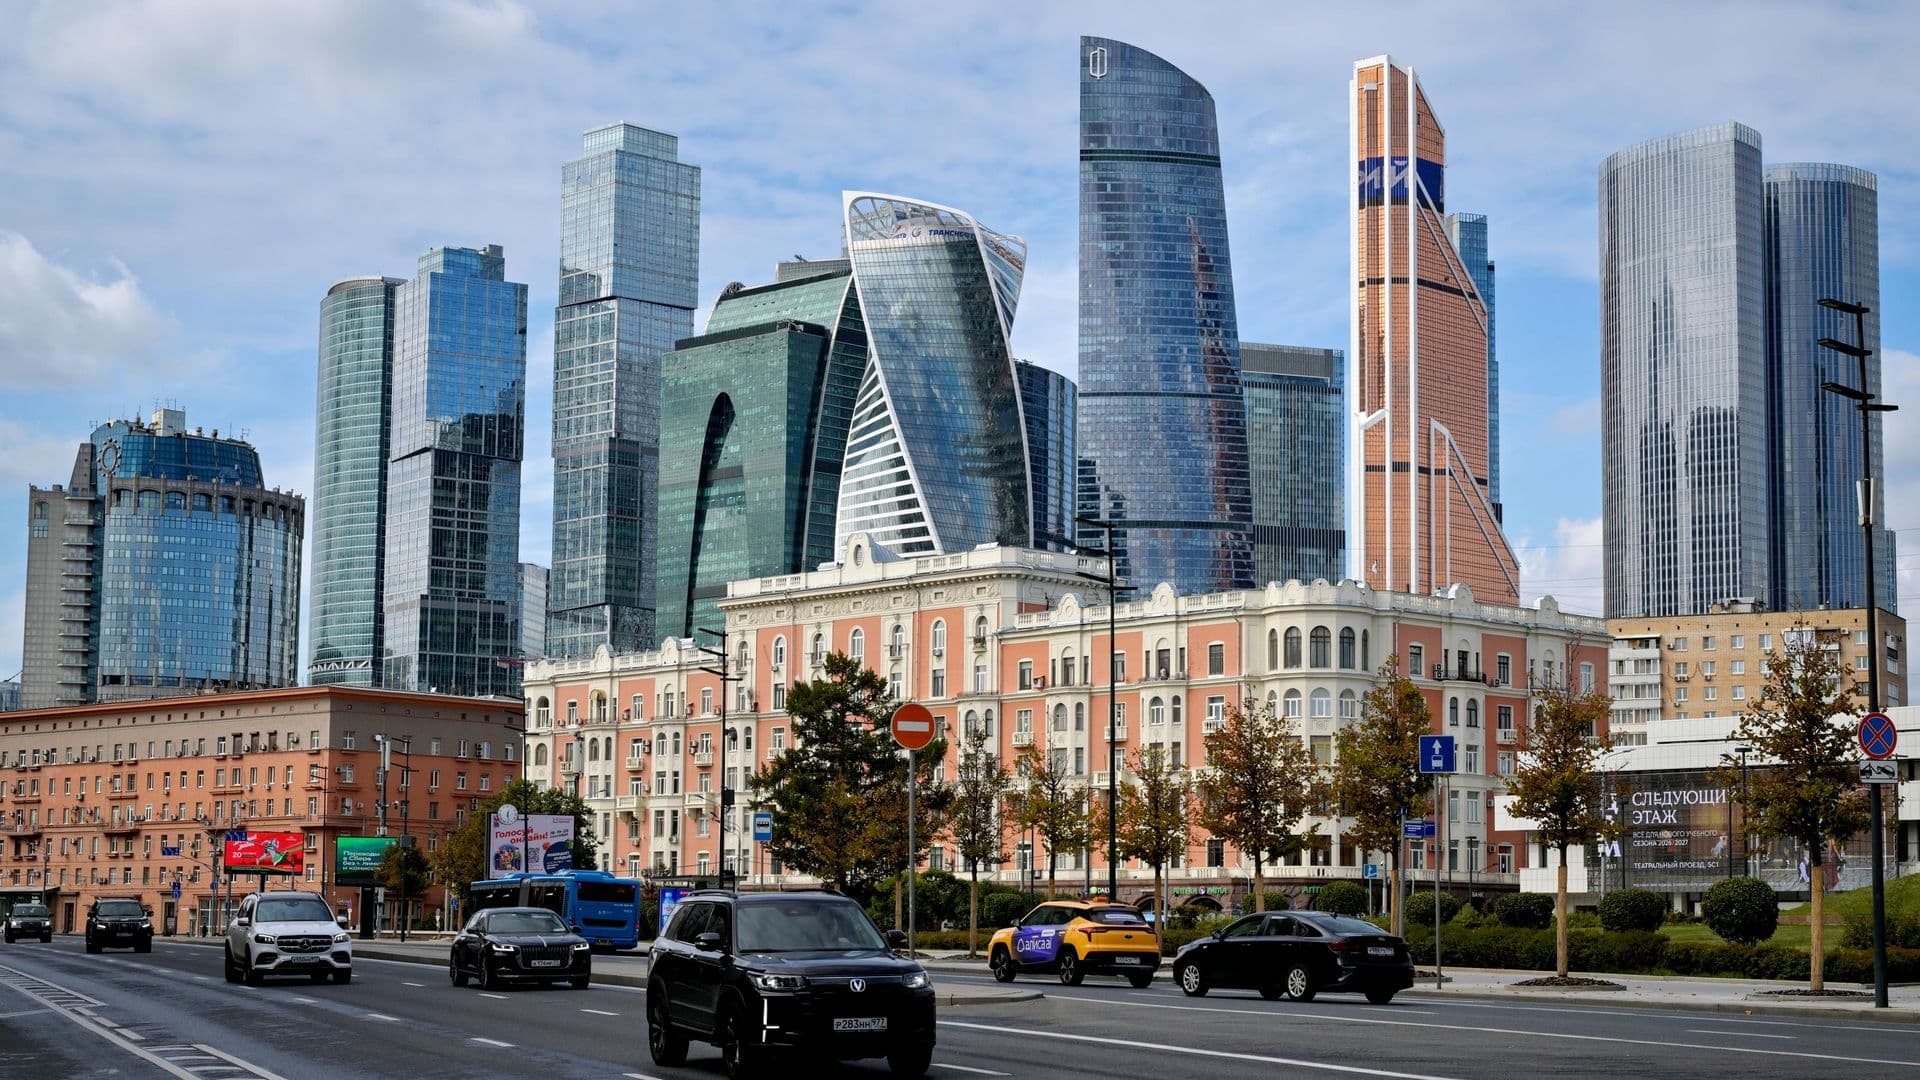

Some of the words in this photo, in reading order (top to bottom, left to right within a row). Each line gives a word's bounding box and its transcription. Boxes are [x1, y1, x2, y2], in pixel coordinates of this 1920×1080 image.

[1632, 809, 1677, 824] ЭТАЖ
[1633, 839, 1657, 847] СЕЗОНА
[1633, 860, 1678, 869] ТЕАТРАЛЬНЫЙ
